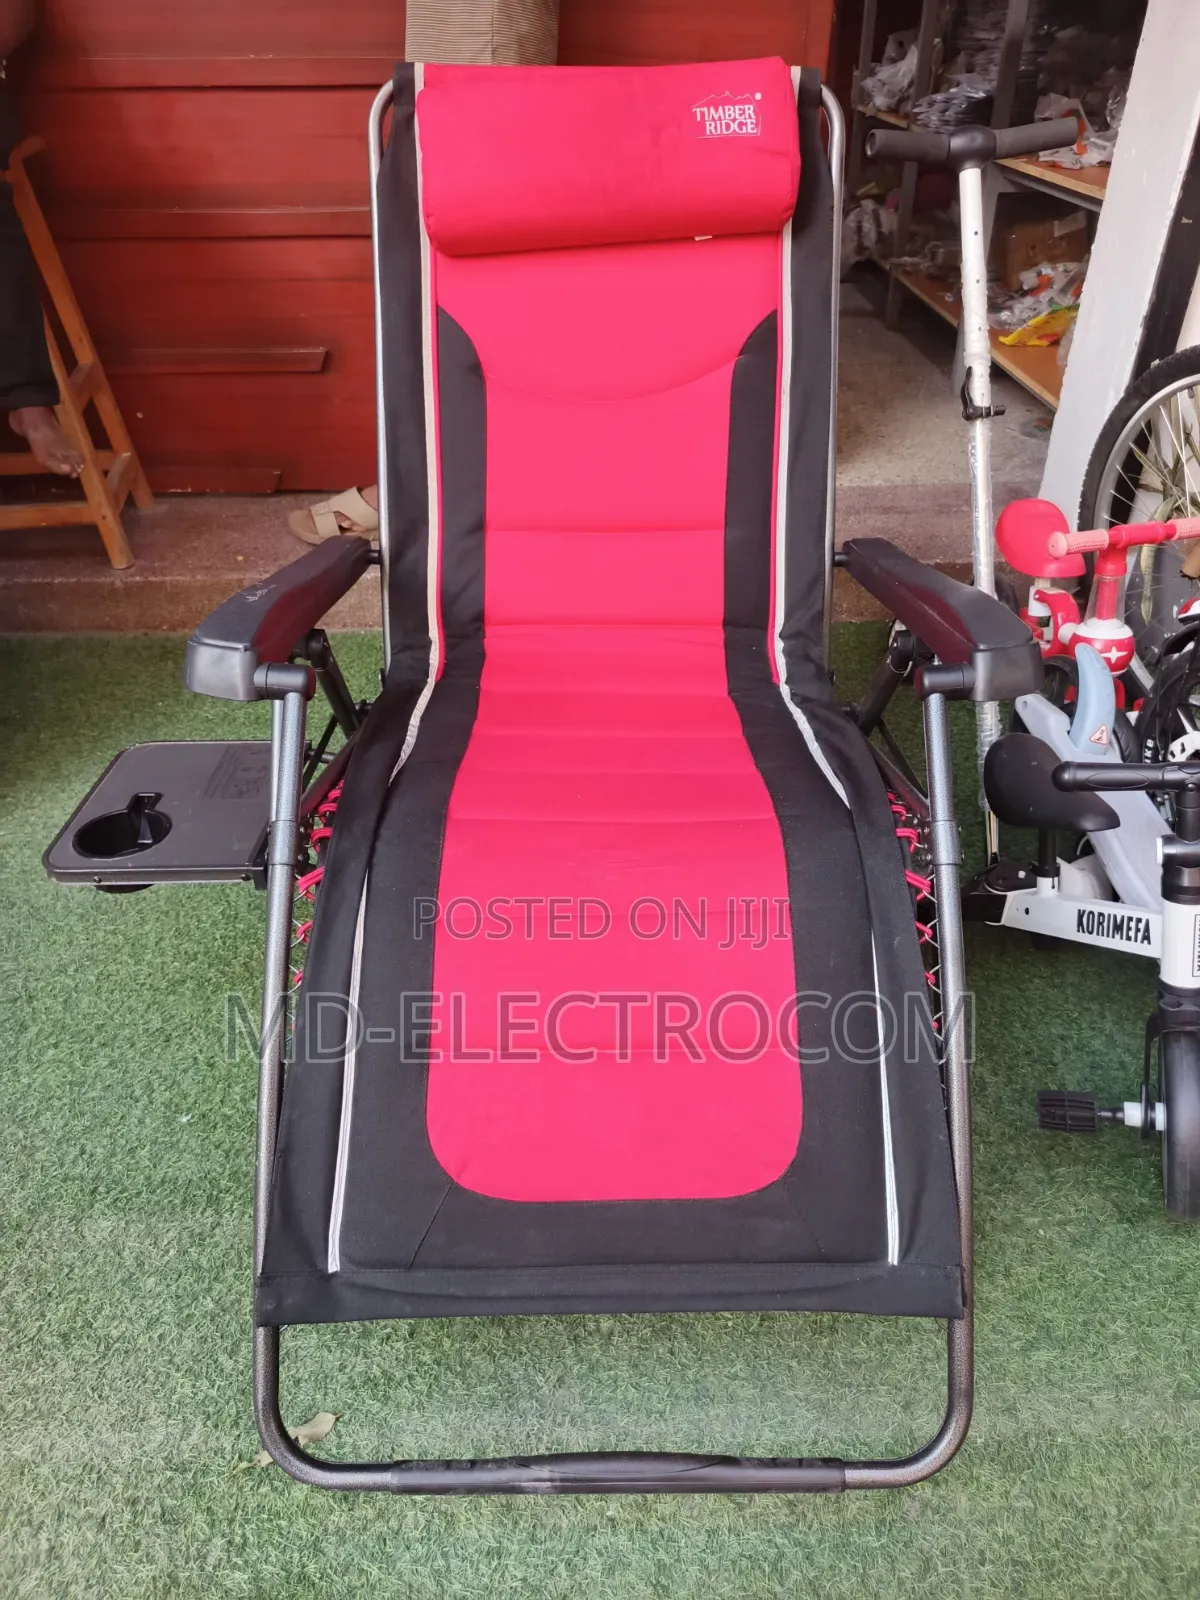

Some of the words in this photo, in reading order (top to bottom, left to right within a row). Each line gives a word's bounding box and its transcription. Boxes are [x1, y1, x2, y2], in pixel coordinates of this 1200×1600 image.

[692, 104, 756, 122] TIMBER
[705, 119, 757, 135] RIDGE
[1076, 908, 1152, 946] KORIMEFA
